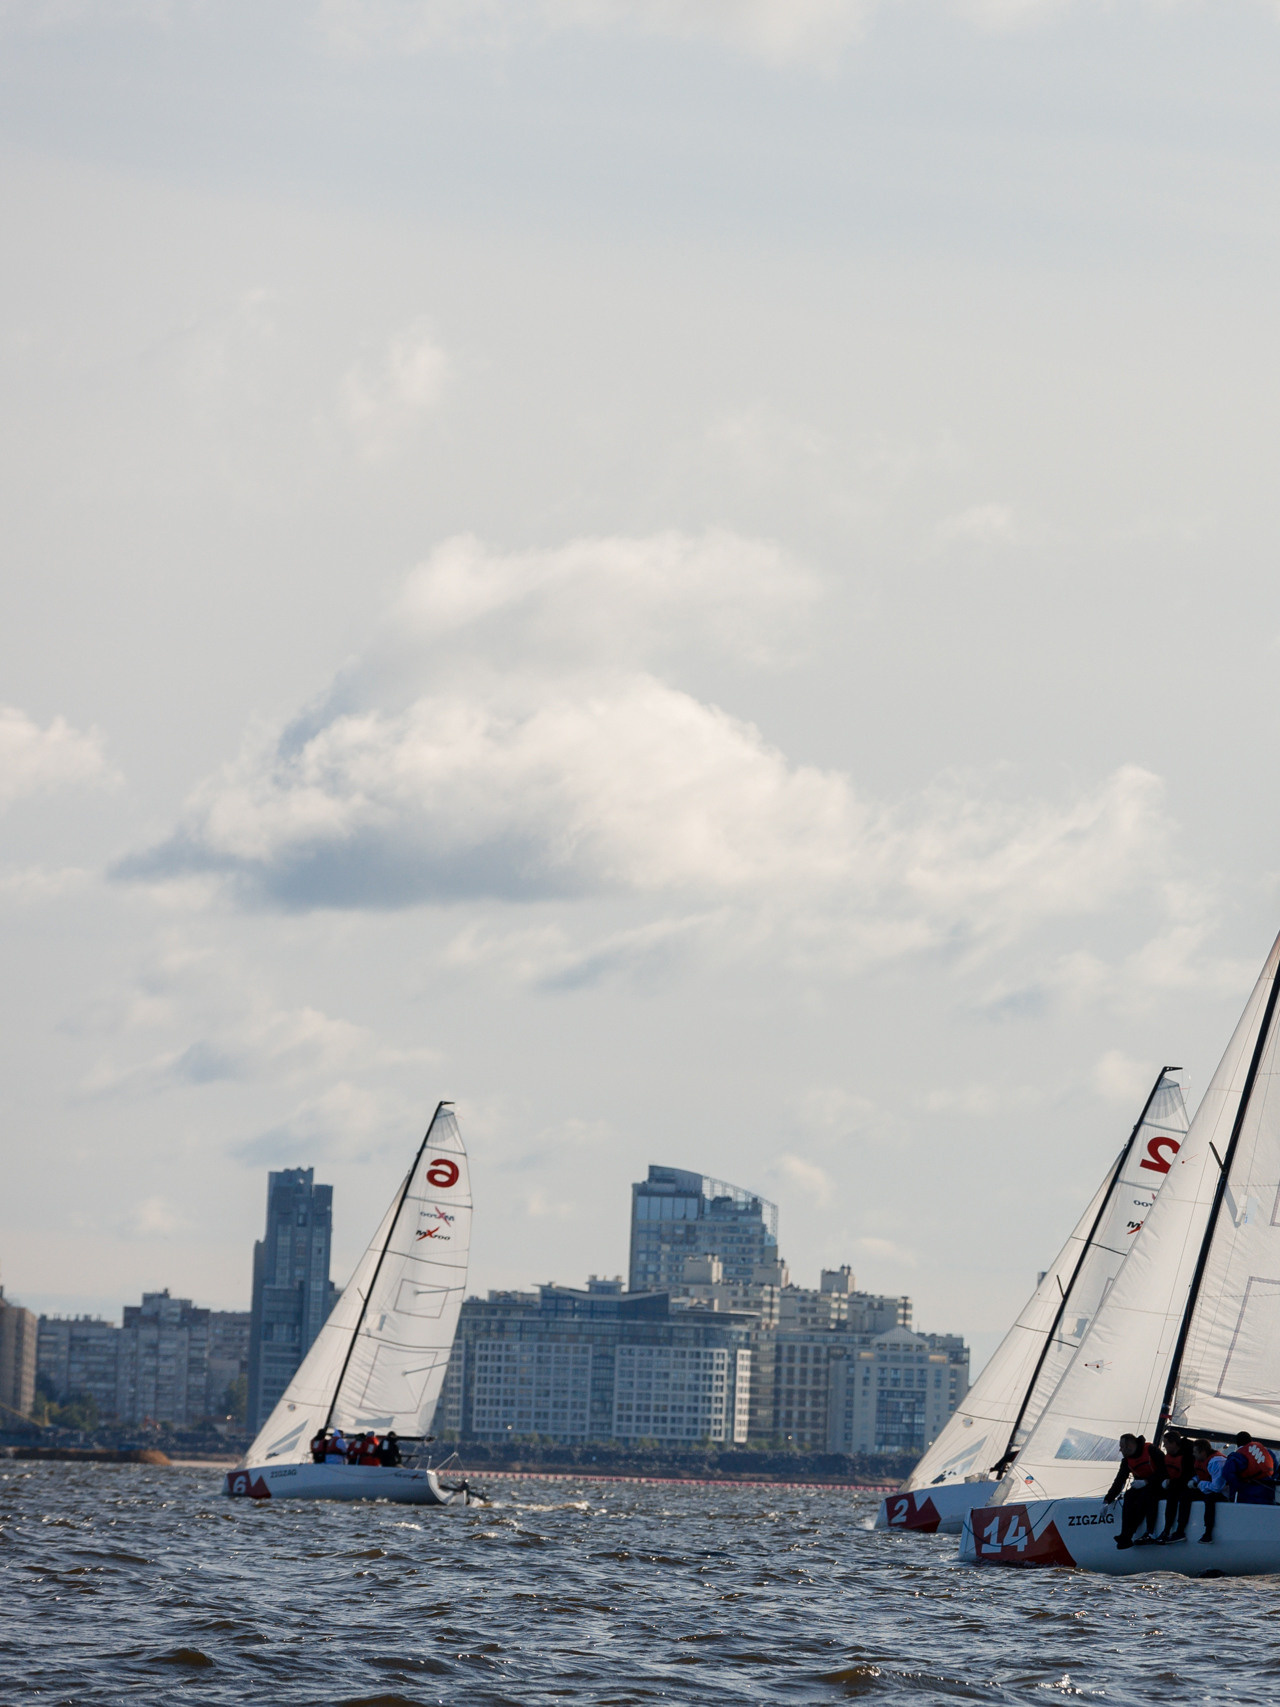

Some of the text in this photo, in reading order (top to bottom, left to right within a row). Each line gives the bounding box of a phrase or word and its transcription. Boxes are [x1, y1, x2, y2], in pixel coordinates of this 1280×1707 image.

[233, 1475, 247, 1494] 6
[891, 1499, 908, 1524] 2
[1068, 1513, 1115, 1527] ZIGZAG
[981, 1515, 1028, 1553] 14
